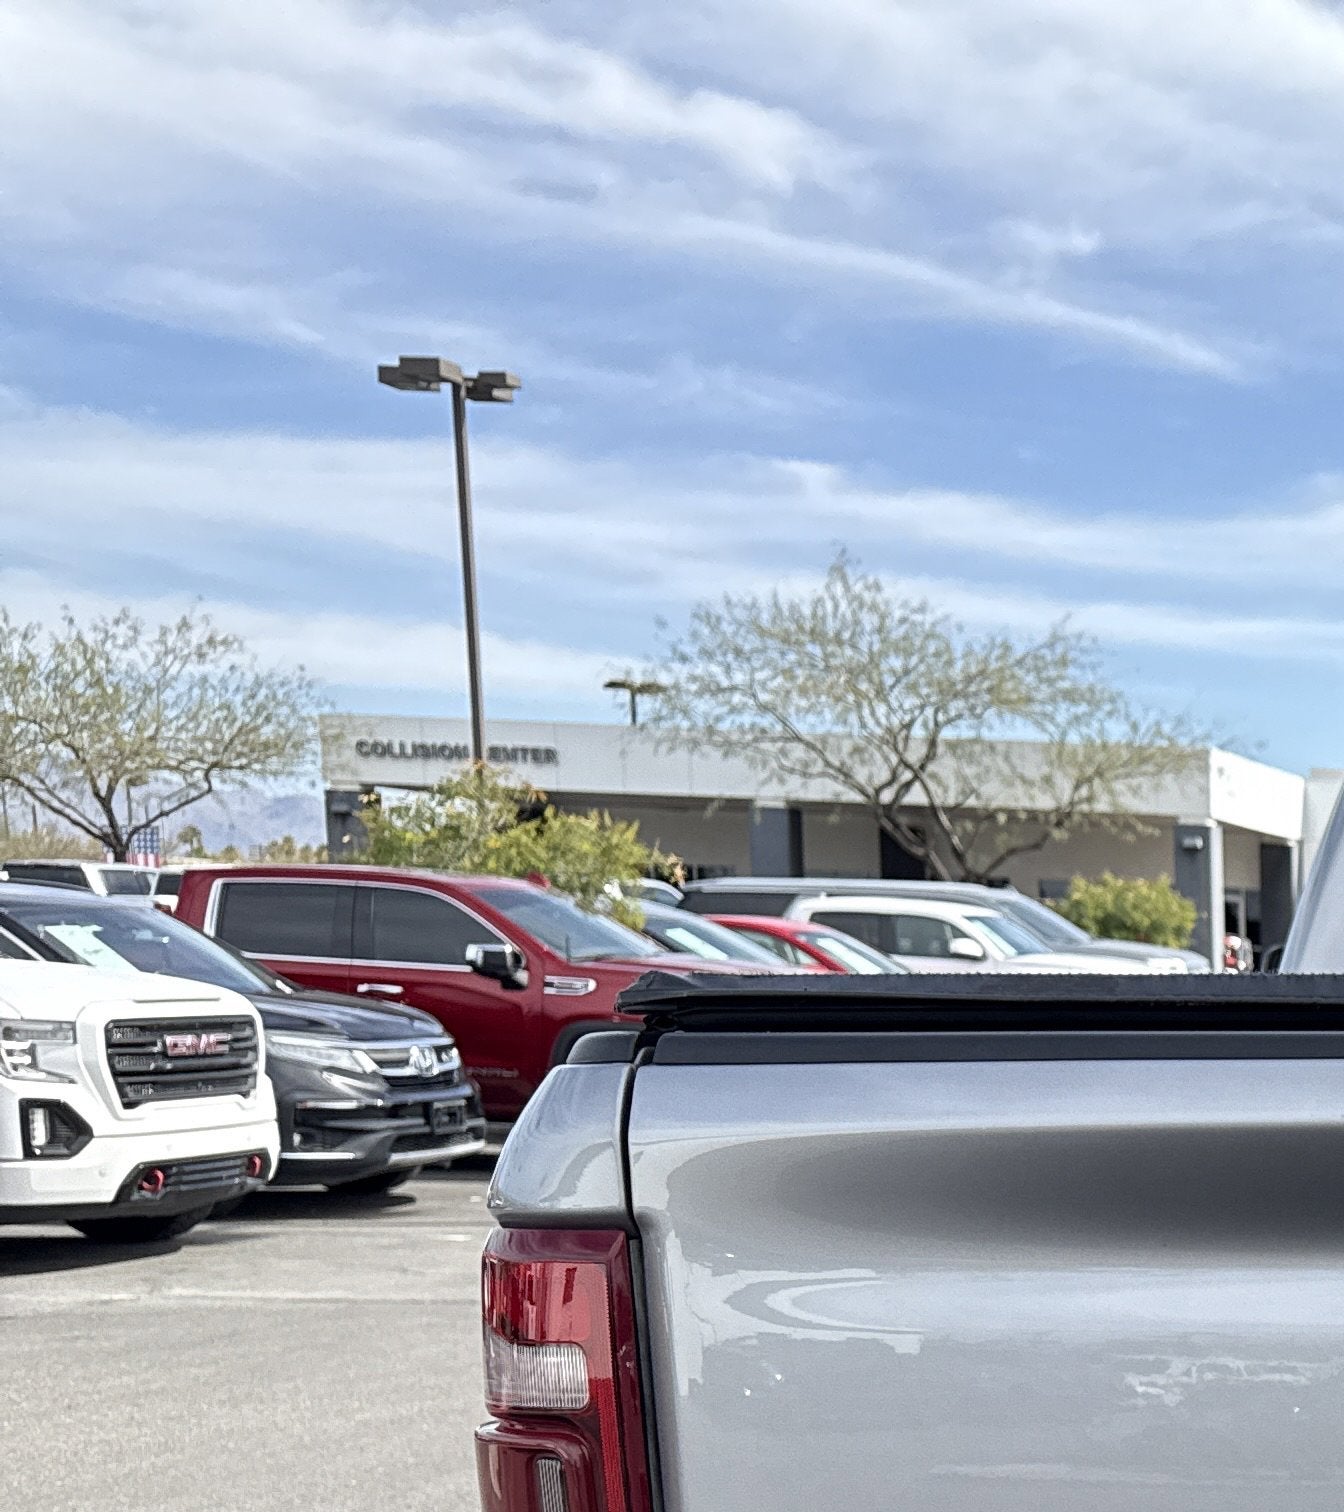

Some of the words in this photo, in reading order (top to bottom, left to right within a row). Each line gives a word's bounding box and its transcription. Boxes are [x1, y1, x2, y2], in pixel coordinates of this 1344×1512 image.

[355, 739, 469, 760] COLLISION
[487, 744, 559, 766] ENTER
[164, 1032, 231, 1057] GMC
